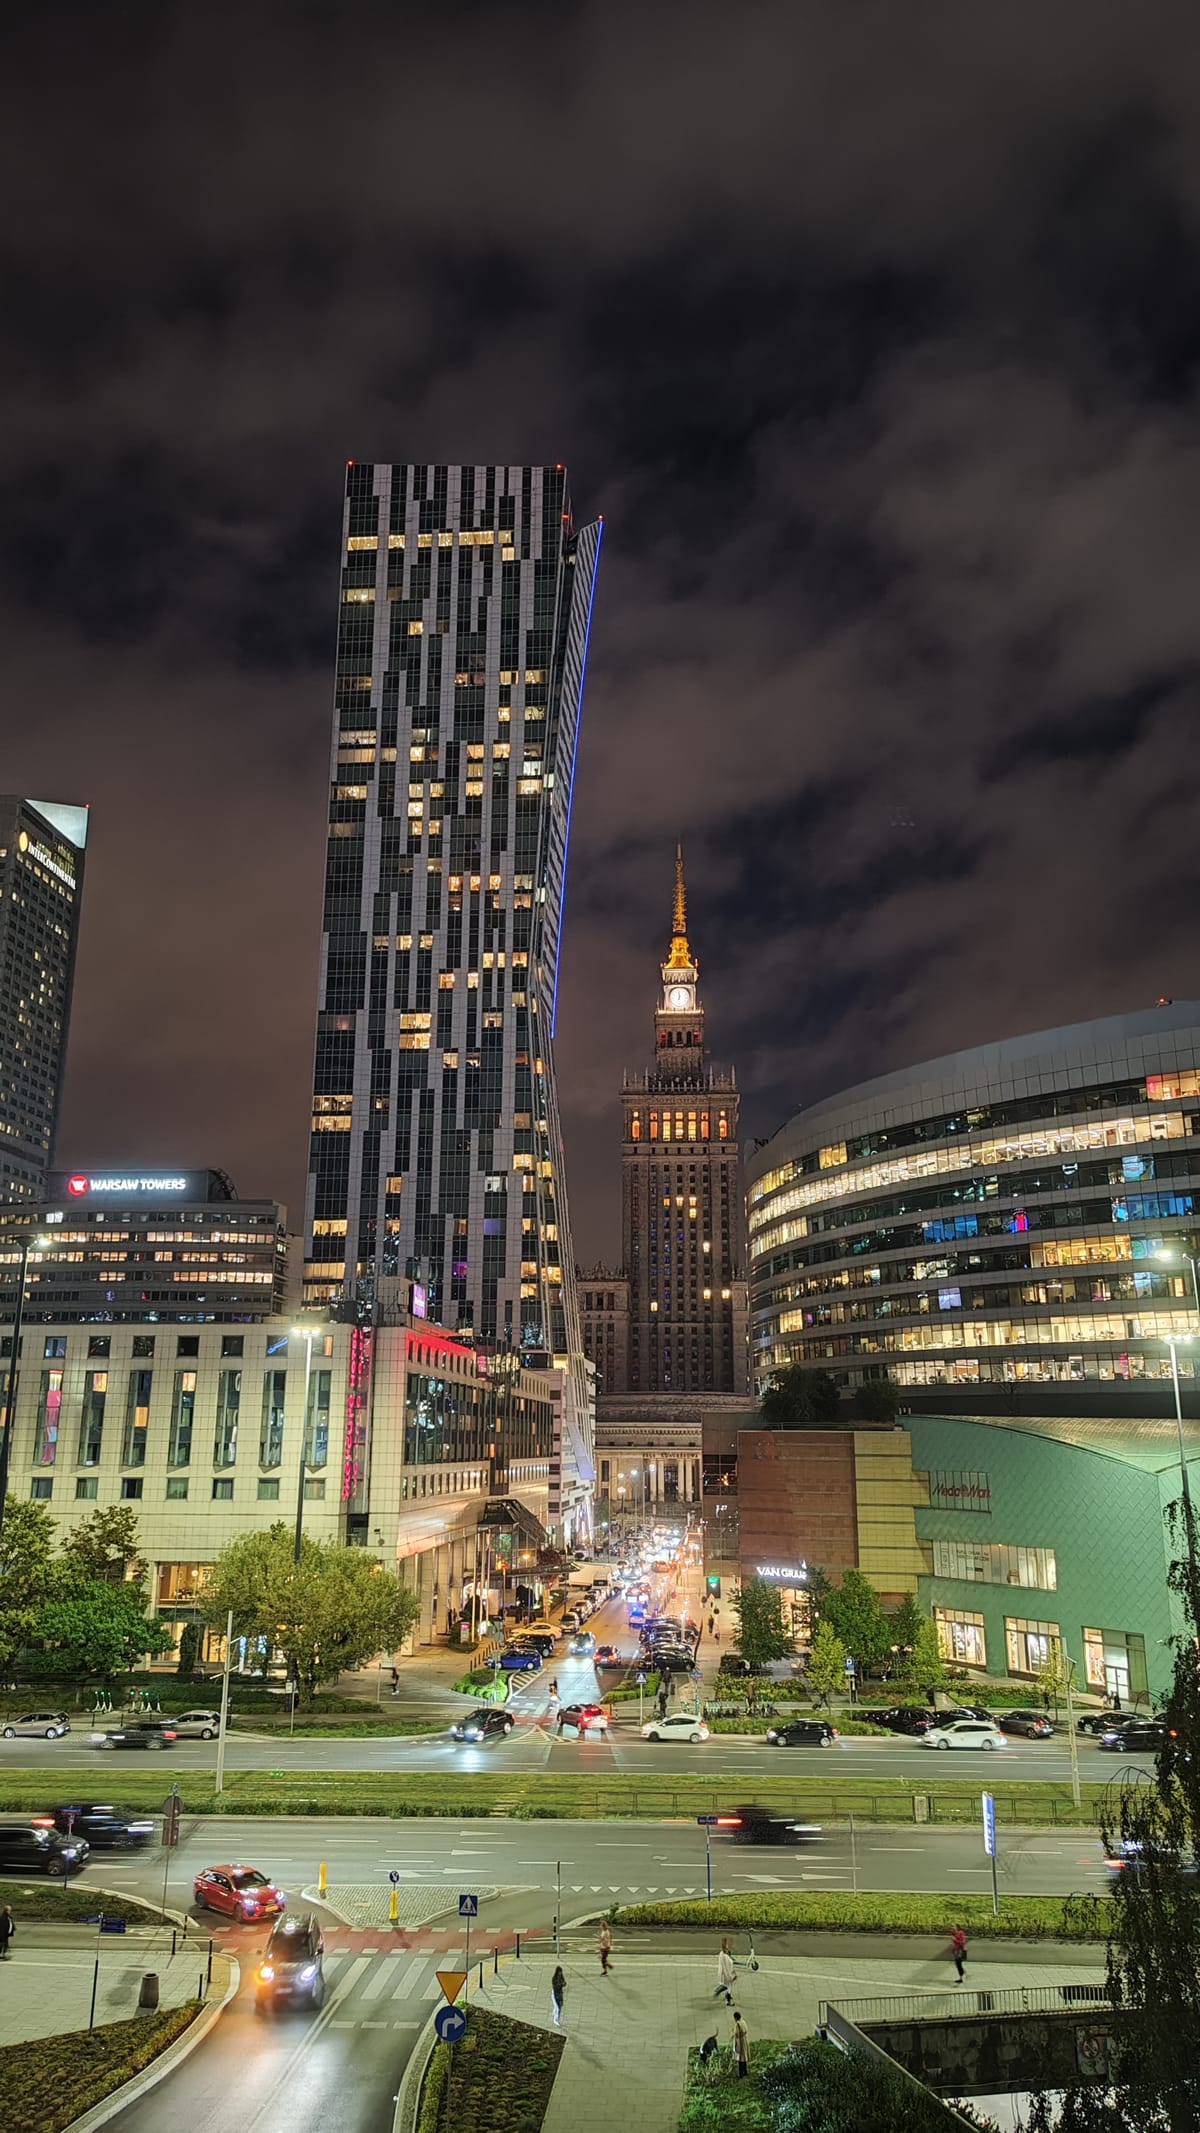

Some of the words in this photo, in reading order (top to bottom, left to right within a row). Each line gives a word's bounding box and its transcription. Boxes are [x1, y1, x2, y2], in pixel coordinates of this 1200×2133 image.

[90, 1178, 139, 1191] WARSAW
[140, 1178, 186, 1190] TOWERS
[756, 1566, 780, 1577] VAN
